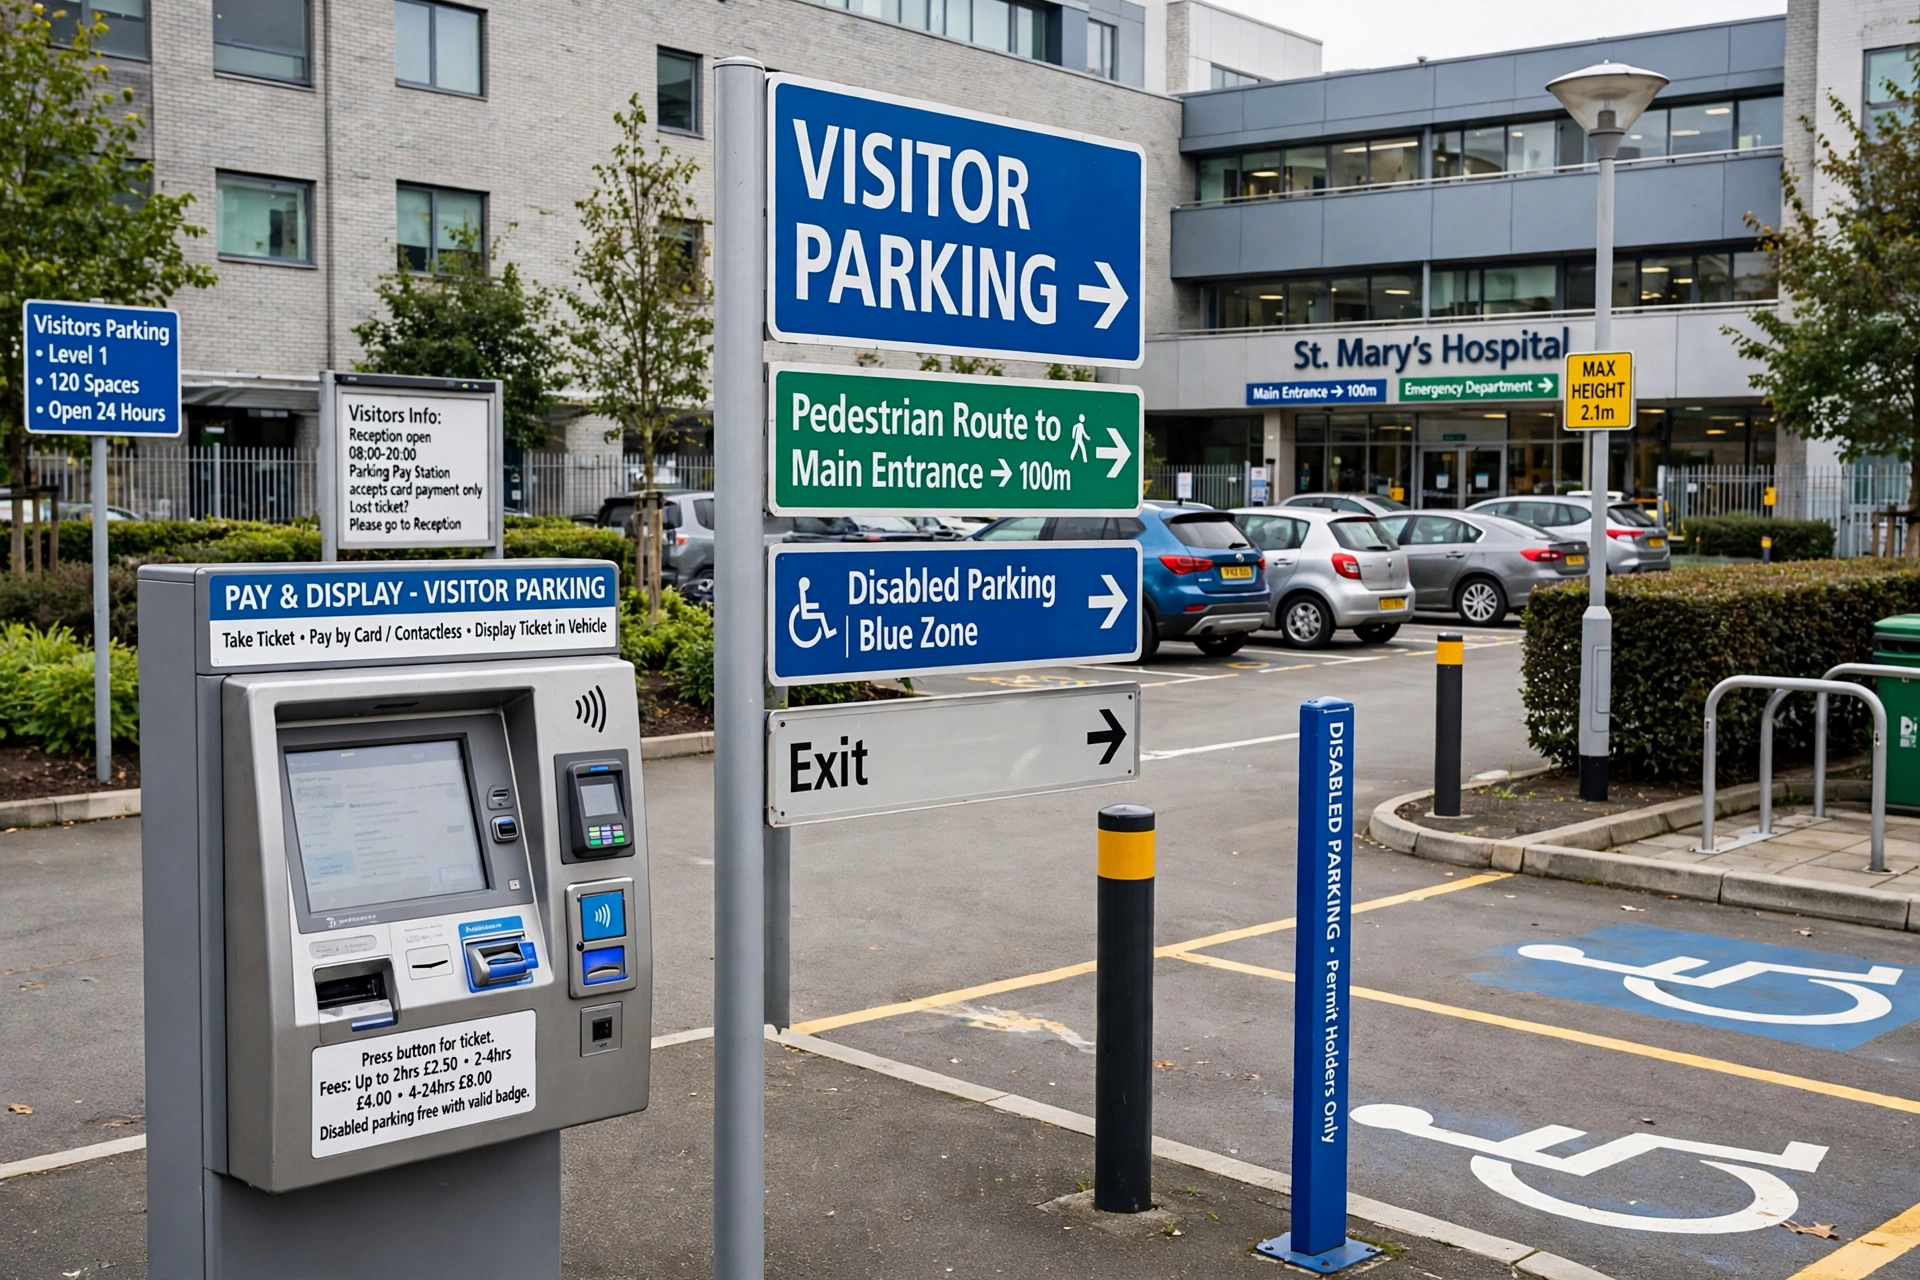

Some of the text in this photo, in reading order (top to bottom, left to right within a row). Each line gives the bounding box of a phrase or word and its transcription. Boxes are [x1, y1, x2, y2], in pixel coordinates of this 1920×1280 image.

[792, 119, 1031, 231] VISITOR
[796, 222, 1057, 325] PARKING
[33, 314, 169, 346] Visitors Parking
[49, 343, 107, 365] Level 1
[1294, 327, 1569, 374] St. Mary's Hospital
[1583, 360, 1615, 377] MAX
[50, 372, 140, 397] 120 Spaces
[1253, 384, 1377, 400] Main Entrance 100m
[1405, 380, 1533, 398] Emergency Department
[1572, 382, 1625, 399] HEIGHT
[49, 401, 166, 424] Open 24 Hours
[348, 404, 441, 424] Visitors Info:
[793, 393, 1061, 441] Pedestrian Route to
[1581, 404, 1614, 420] 2.1m
[349, 427, 431, 447] Reception open
[349, 463, 450, 482] Parking Pay Station
[792, 449, 1071, 490] Main Entrance 100m
[349, 482, 483, 499] accepts card payment only
[350, 499, 409, 513] Lost ticket?
[350, 517, 461, 534] Please go to Reception
[226, 584, 272, 610] PAY
[280, 584, 298, 609] &
[307, 581, 403, 608] DISPLAY
[423, 579, 509, 604] VISITOR
[516, 576, 605, 601] PARKING
[849, 565, 1055, 608] Disabled Parking
[222, 617, 607, 648] Take Ticket Pay by Card / Contactless Display Ticket in Vehicle
[860, 616, 978, 651] Blue Zone
[790, 736, 868, 793] Exit
[1321, 722, 1344, 1143] DISABLED PARKING Permit Holders Only
[362, 1031, 494, 1067] Press button for ticket.
[320, 1047, 512, 1096] Fees: Up to 2hrs £2.50 2-4hrs
[356, 1070, 492, 1111] £4.00 4-24hrs £8.00
[320, 1085, 530, 1141] Disabled parking free with valid badge.
